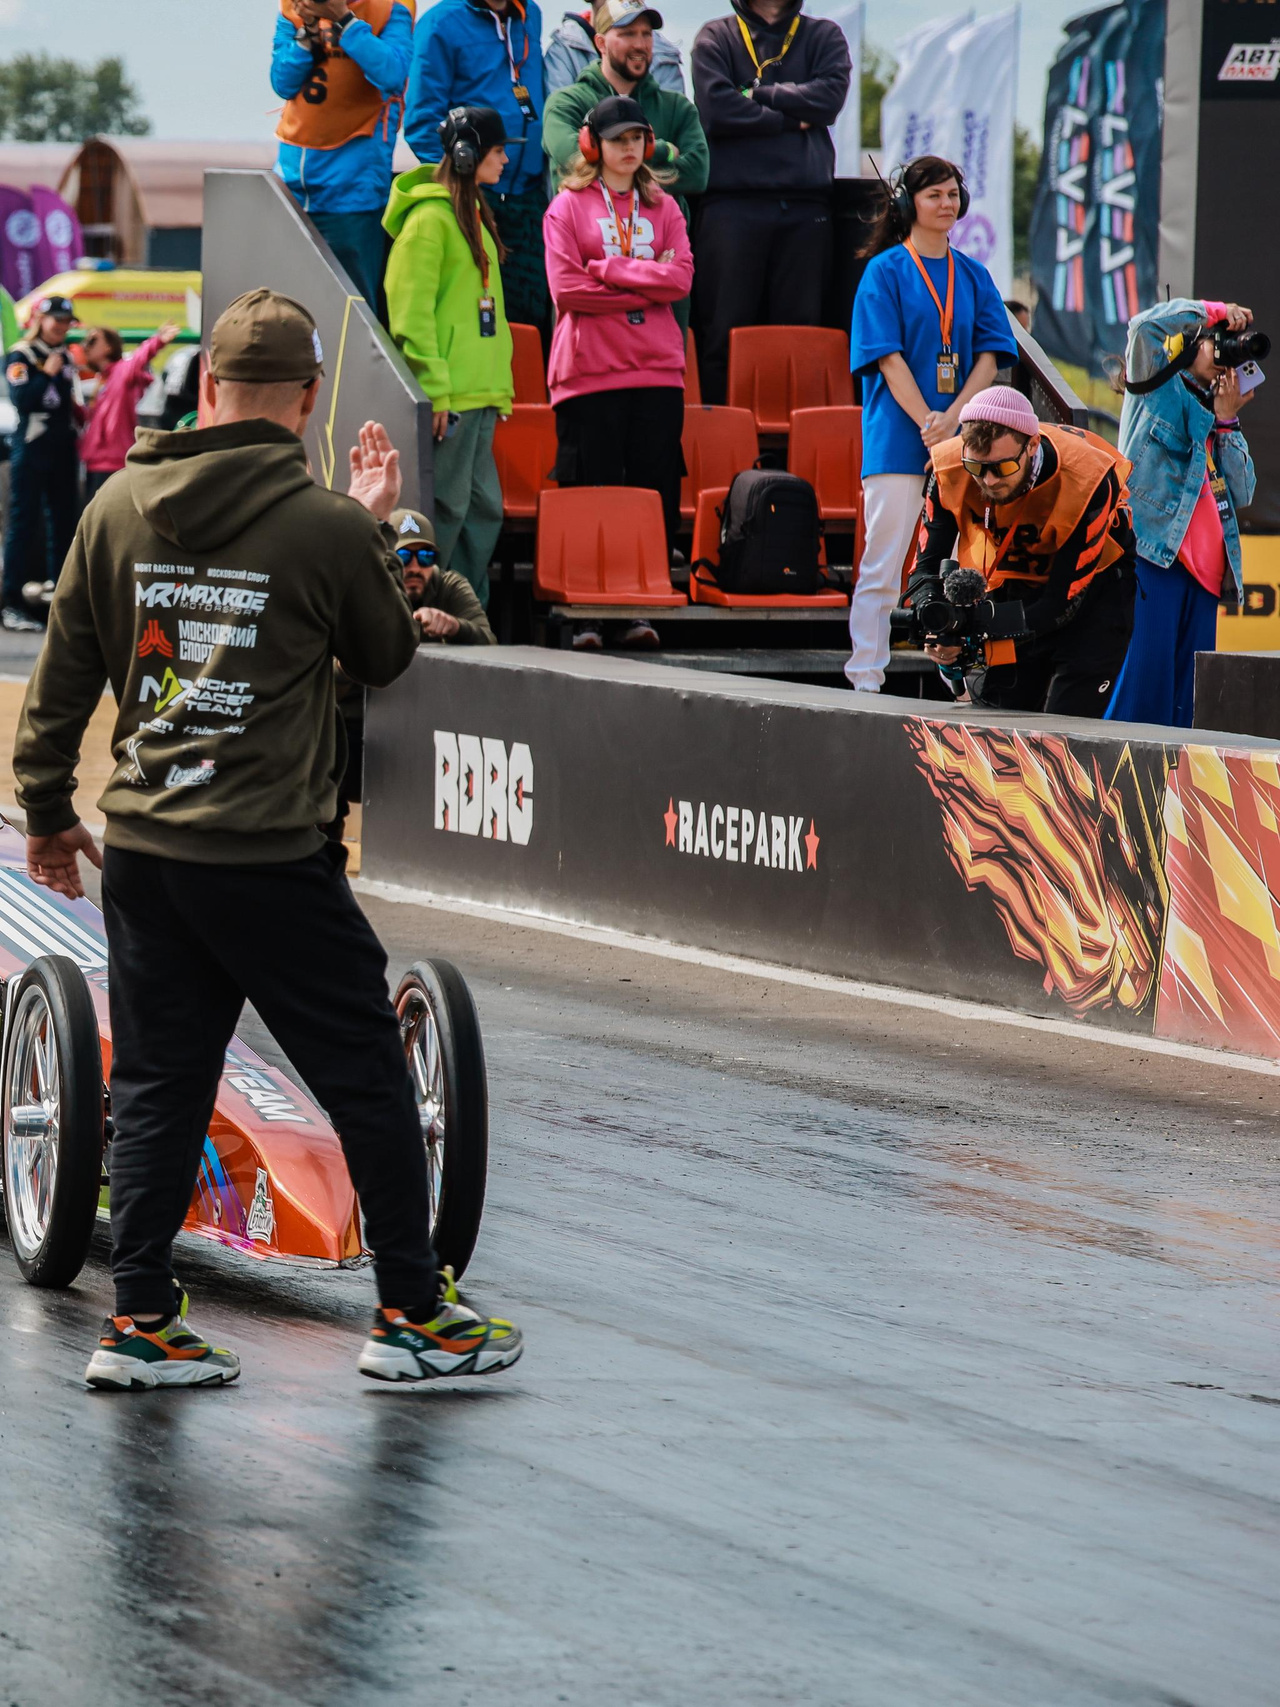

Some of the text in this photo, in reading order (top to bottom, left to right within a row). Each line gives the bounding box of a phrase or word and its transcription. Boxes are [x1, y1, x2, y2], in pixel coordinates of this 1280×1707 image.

[153, 563, 176, 575] RACER
[176, 565, 195, 576] TEAM
[180, 601, 261, 617] MOTORSPORT
[179, 639, 215, 664] СПОРТ
[194, 677, 251, 694] NIGHT
[187, 686, 255, 707] RACER
[184, 698, 244, 718] TEAM
[433, 729, 534, 846] RDRC
[678, 799, 805, 873] RACEPARK
